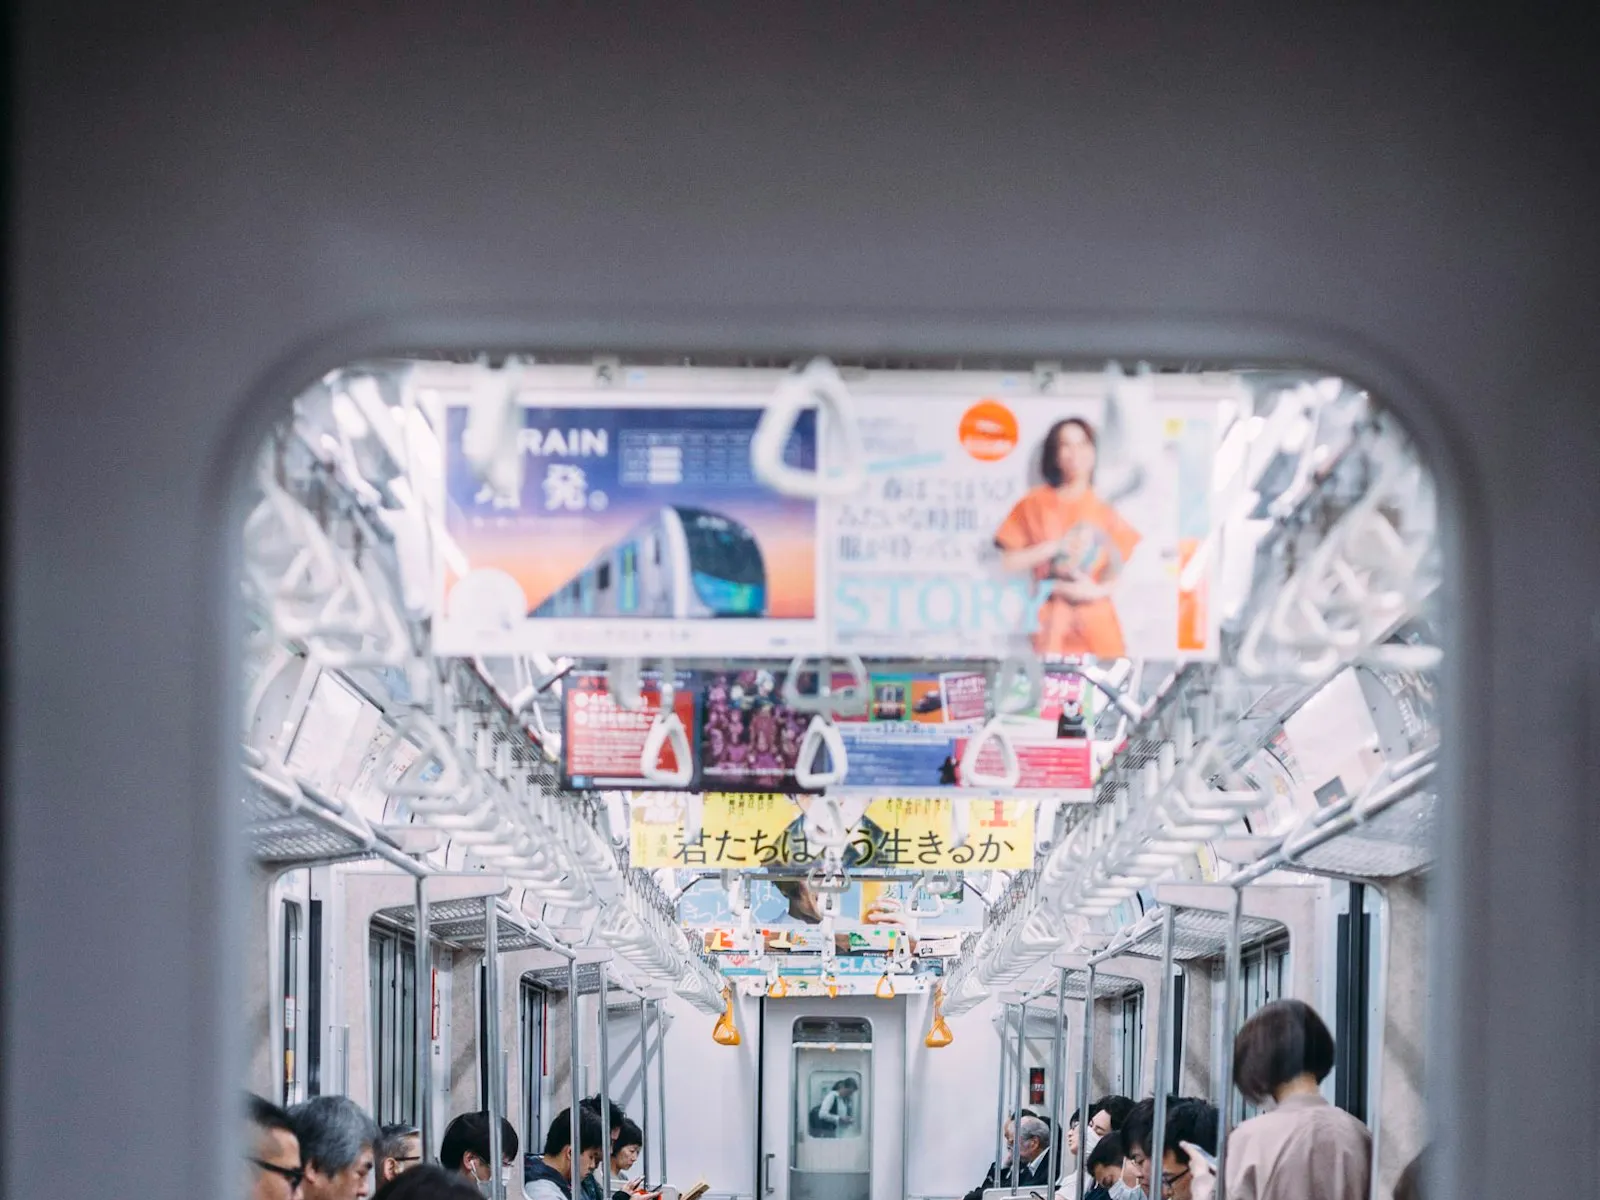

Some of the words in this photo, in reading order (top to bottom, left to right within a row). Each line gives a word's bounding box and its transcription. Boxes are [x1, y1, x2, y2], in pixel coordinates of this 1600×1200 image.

[514, 428, 609, 457] RAIN
[834, 576, 1056, 633] STORY
[673, 827, 1015, 866] 君たちはう生きるか
[833, 956, 888, 973] CLAS
